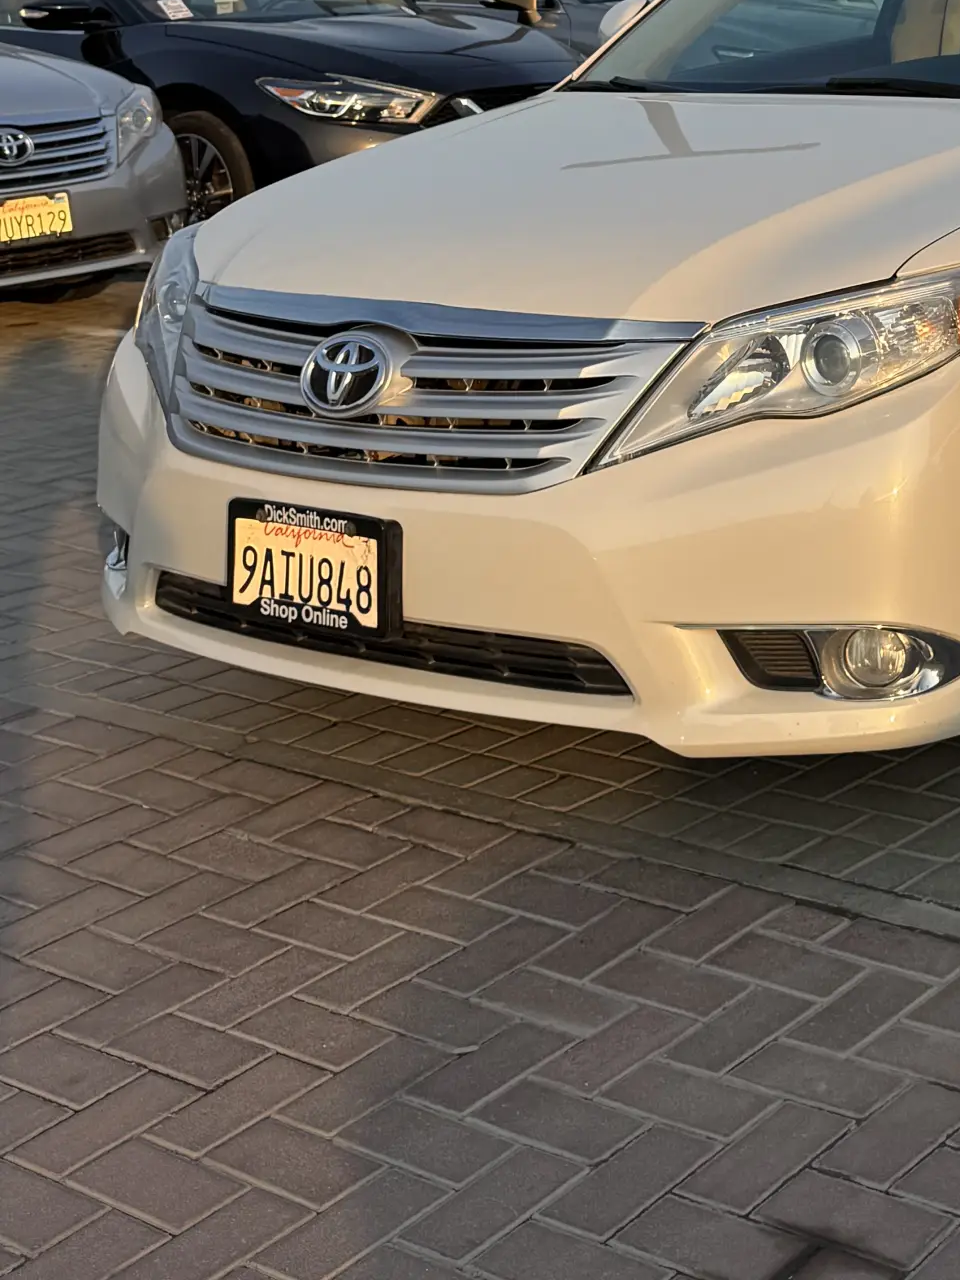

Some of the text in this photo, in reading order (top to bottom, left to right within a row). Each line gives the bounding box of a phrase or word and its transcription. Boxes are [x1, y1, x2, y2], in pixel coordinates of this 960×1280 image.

[0, 209, 67, 239] UYR129
[264, 503, 348, 533] DickSmith.com
[239, 545, 372, 614] 9AIU848
[260, 598, 348, 629] Shop Online
